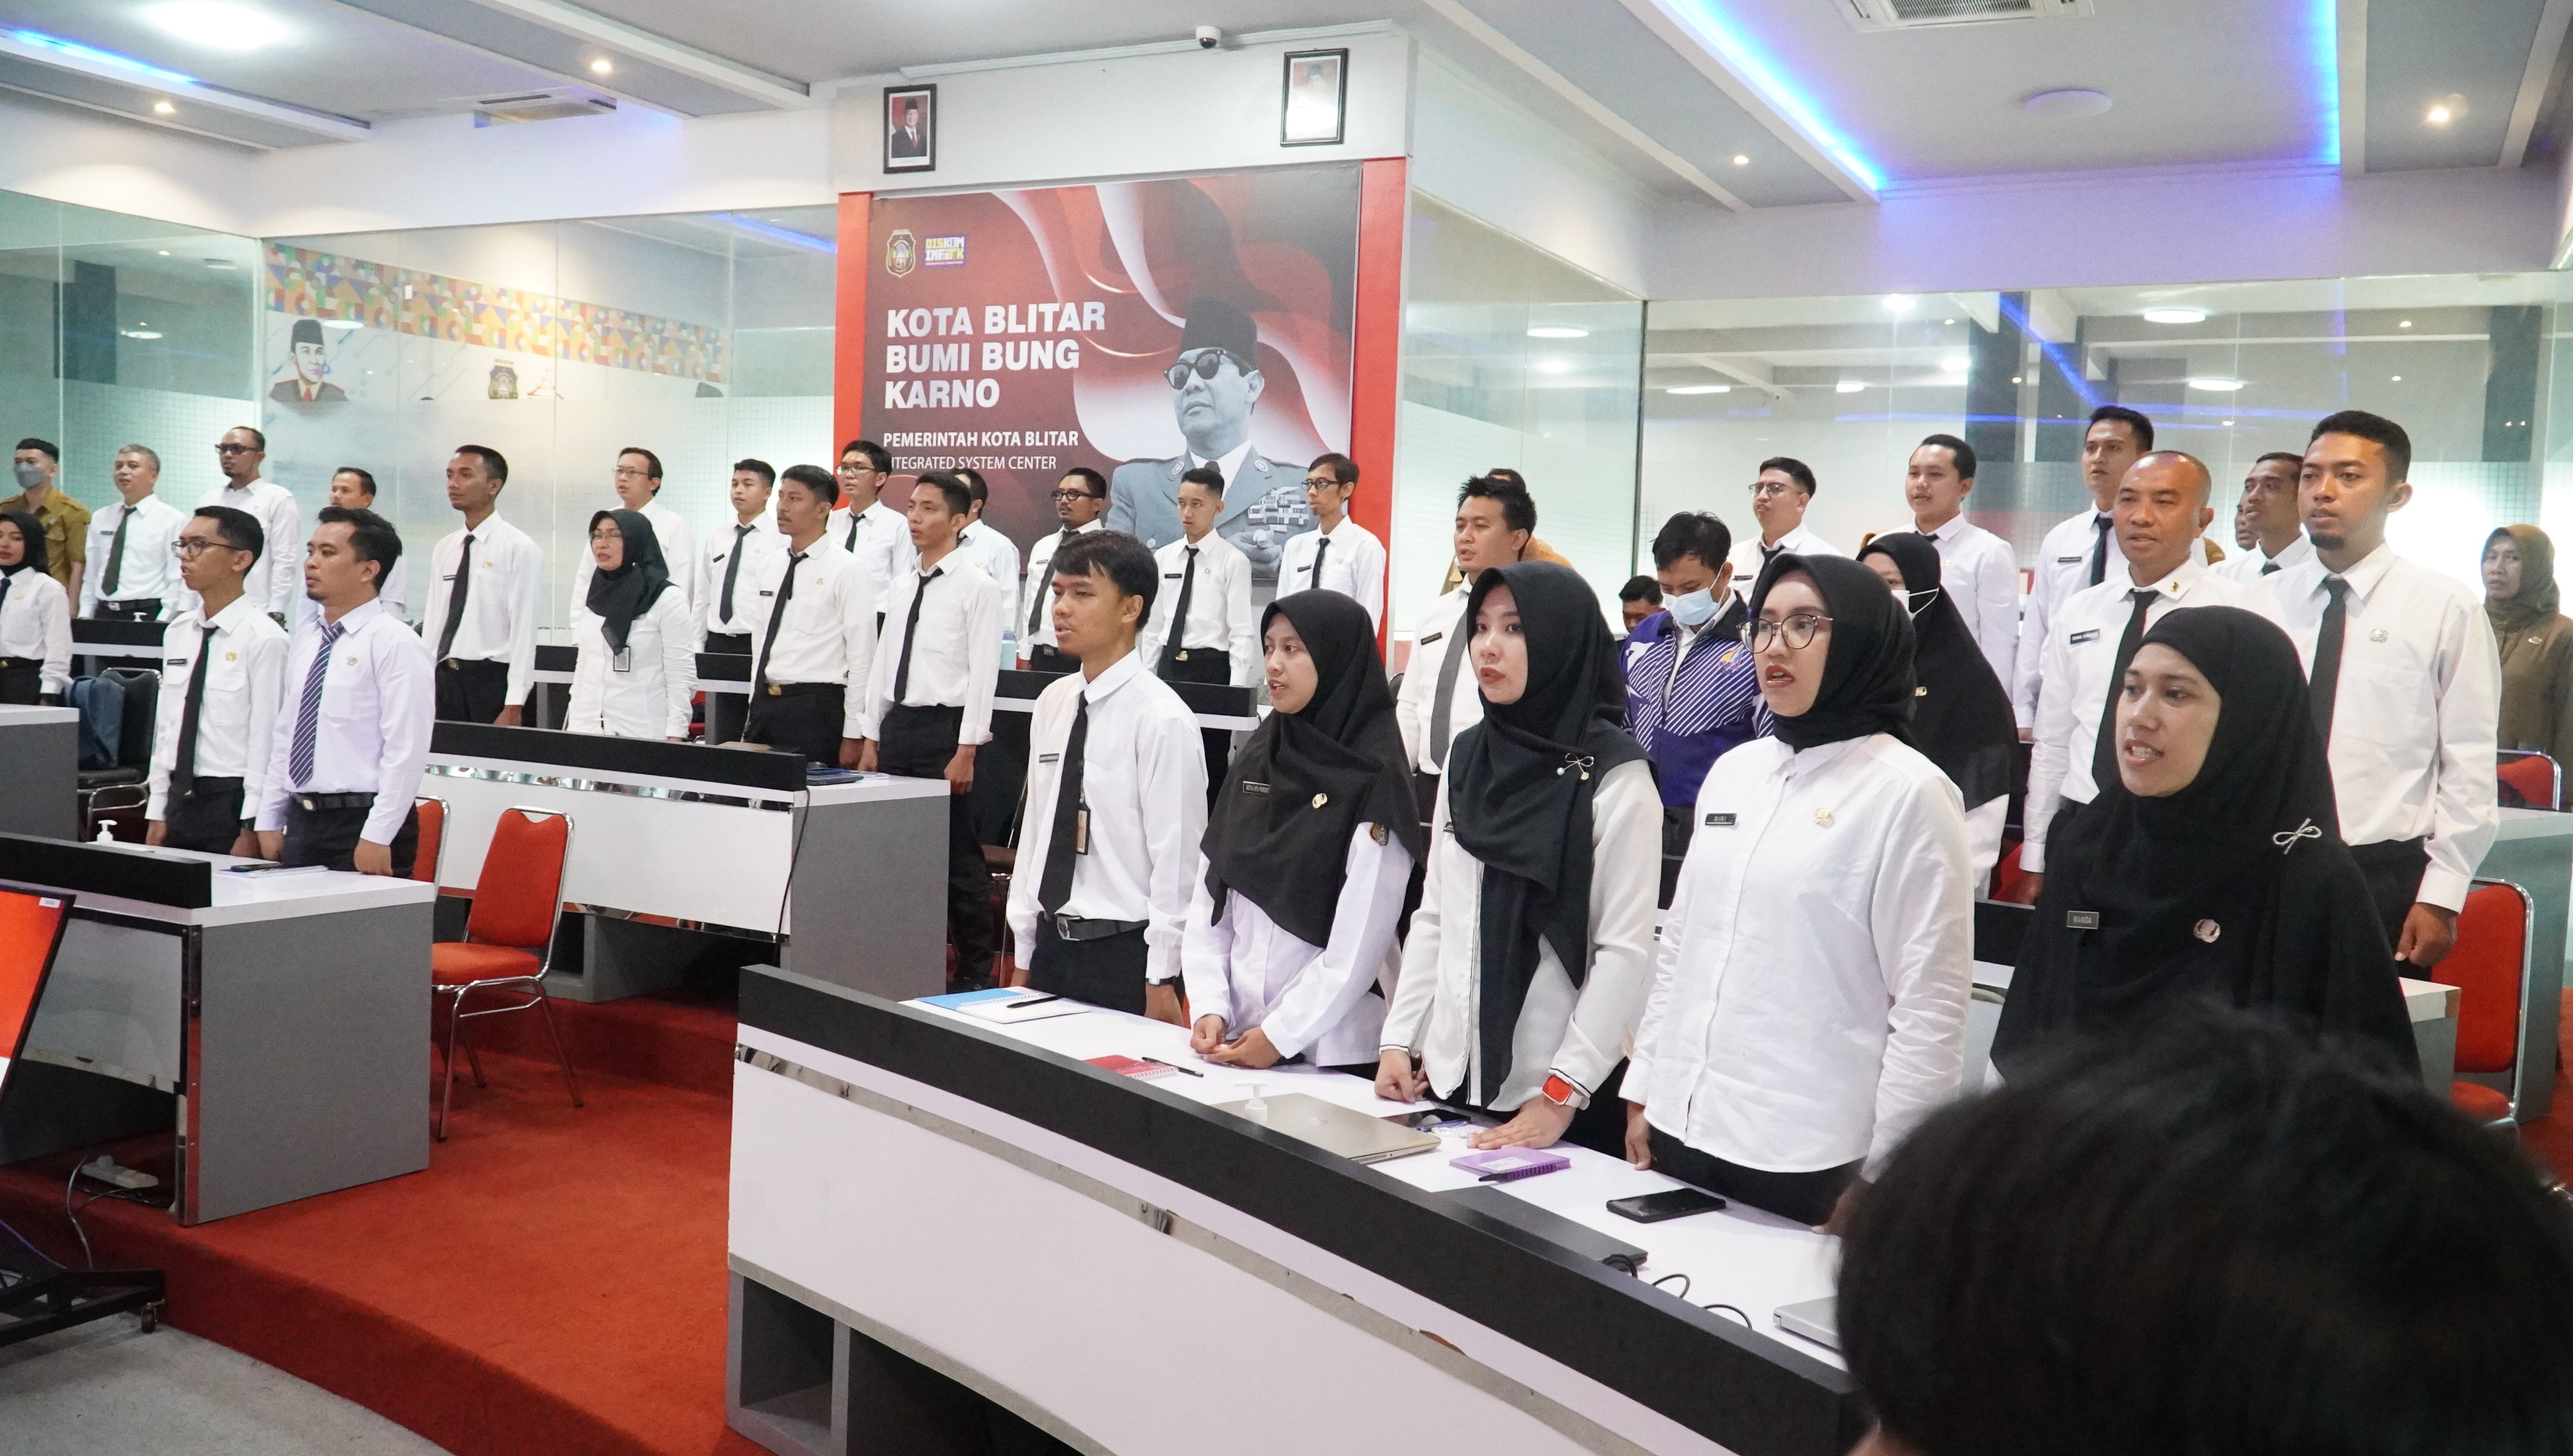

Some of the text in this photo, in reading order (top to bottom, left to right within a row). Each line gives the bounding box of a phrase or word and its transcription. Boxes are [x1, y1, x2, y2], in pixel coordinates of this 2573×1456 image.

[925, 236, 965, 249] DISKOM
[887, 301, 1105, 337] KOTA BLITAR
[886, 339, 1080, 373] BUMI BUNG
[885, 378, 1000, 409] KARNO
[883, 431, 1079, 447] PEMERINTAH KOTA BLITAR
[891, 456, 1057, 470] TEGRATED SYSTEM CENTER
